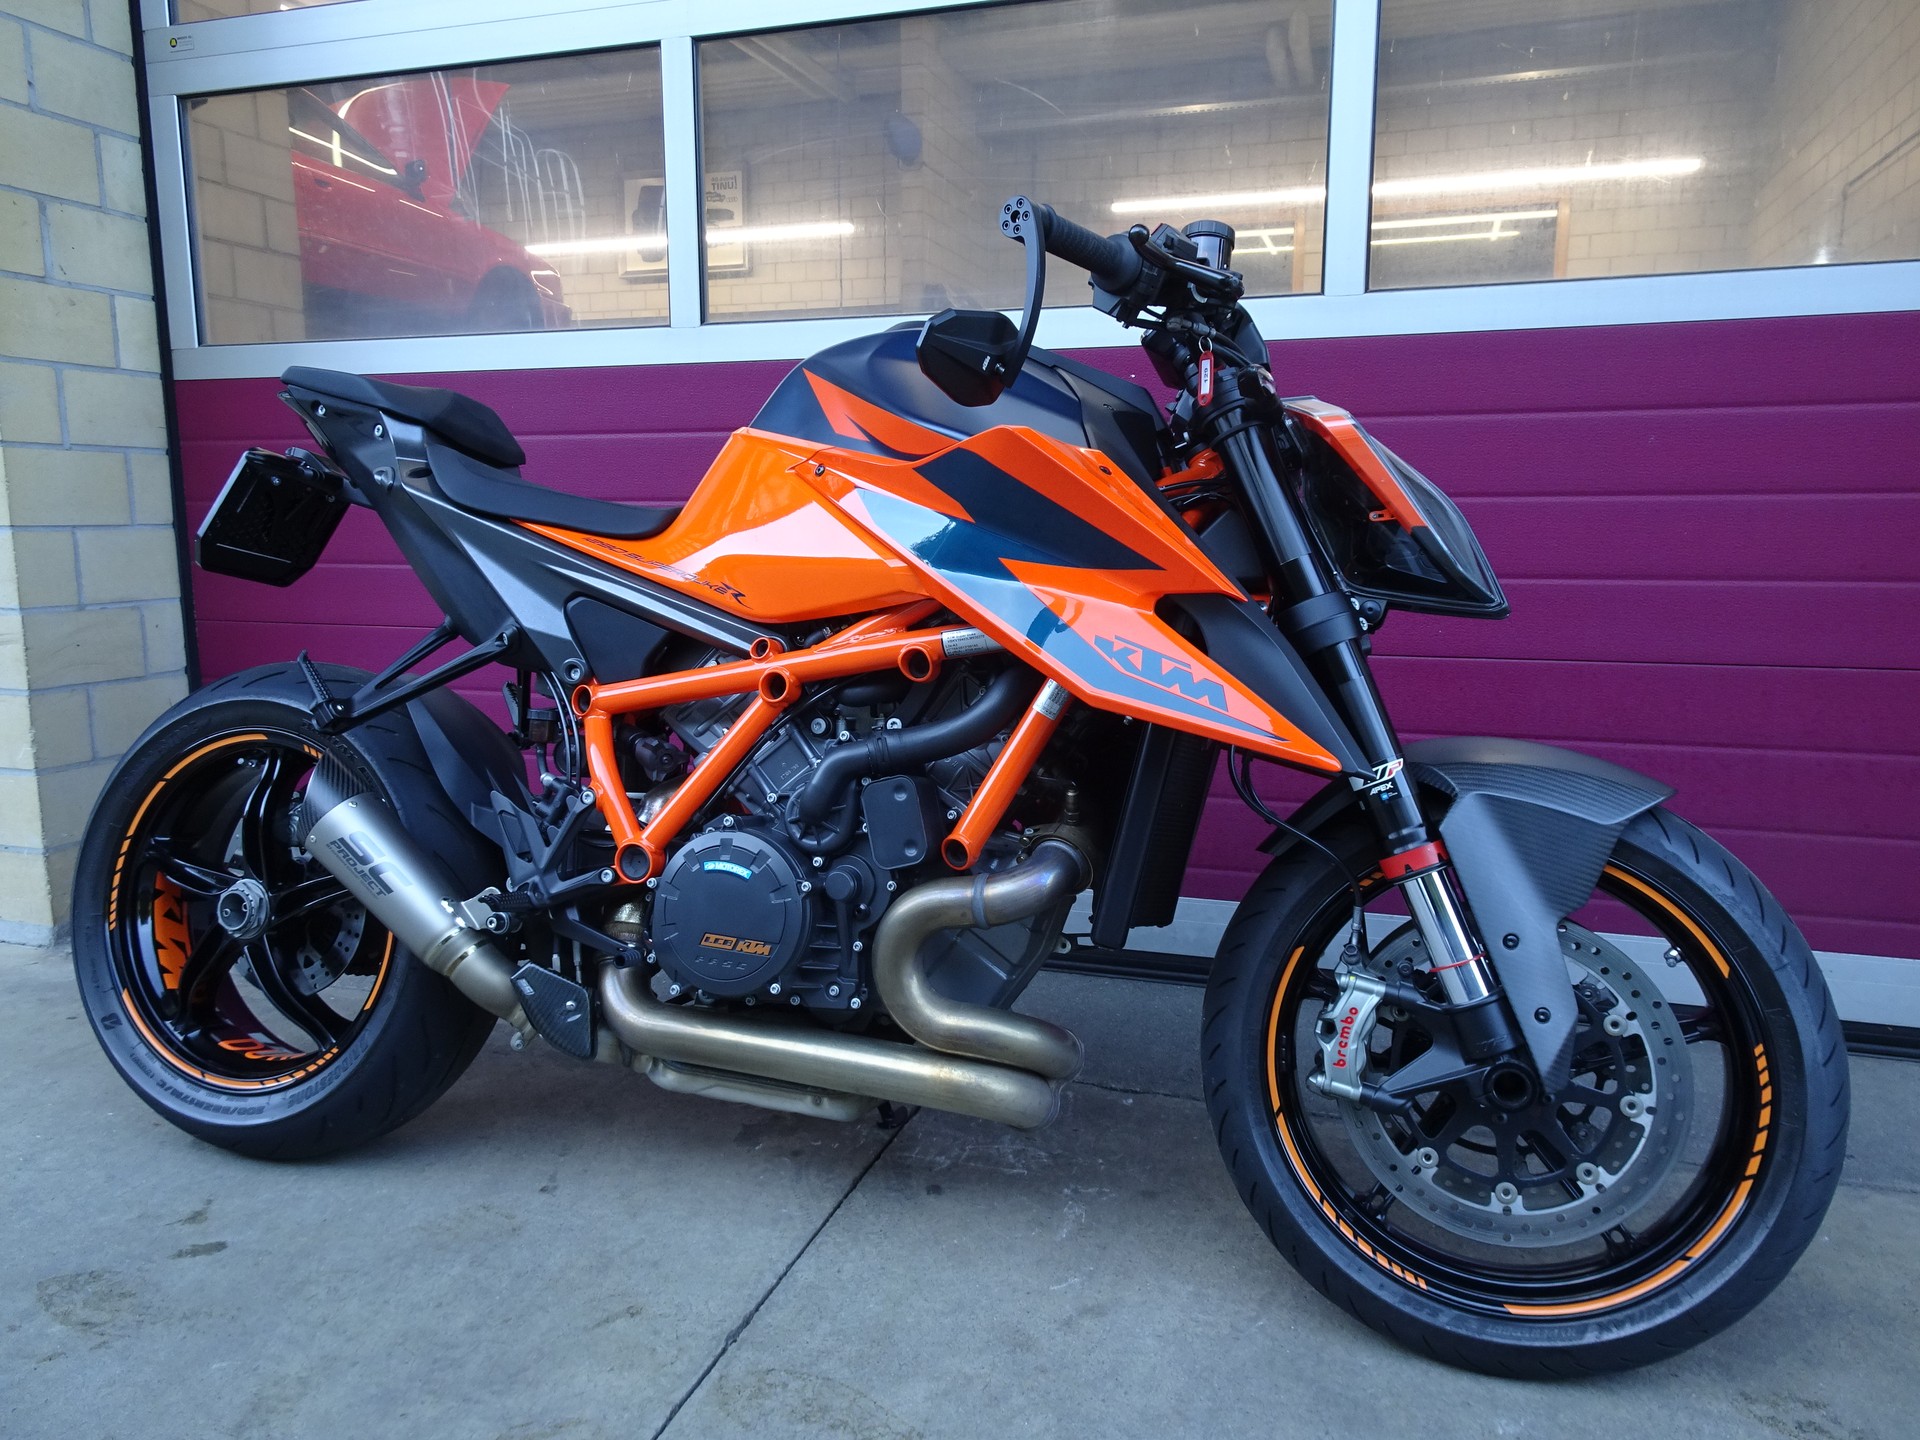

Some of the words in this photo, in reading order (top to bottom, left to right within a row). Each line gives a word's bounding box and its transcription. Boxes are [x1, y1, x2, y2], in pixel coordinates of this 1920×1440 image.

[1094, 634, 1229, 713] KTM
[1369, 781, 1394, 796] APEX
[329, 840, 387, 897] PROJECT
[337, 830, 414, 895] SC
[736, 939, 772, 956] KTM
[1333, 1006, 1359, 1069] brembo
